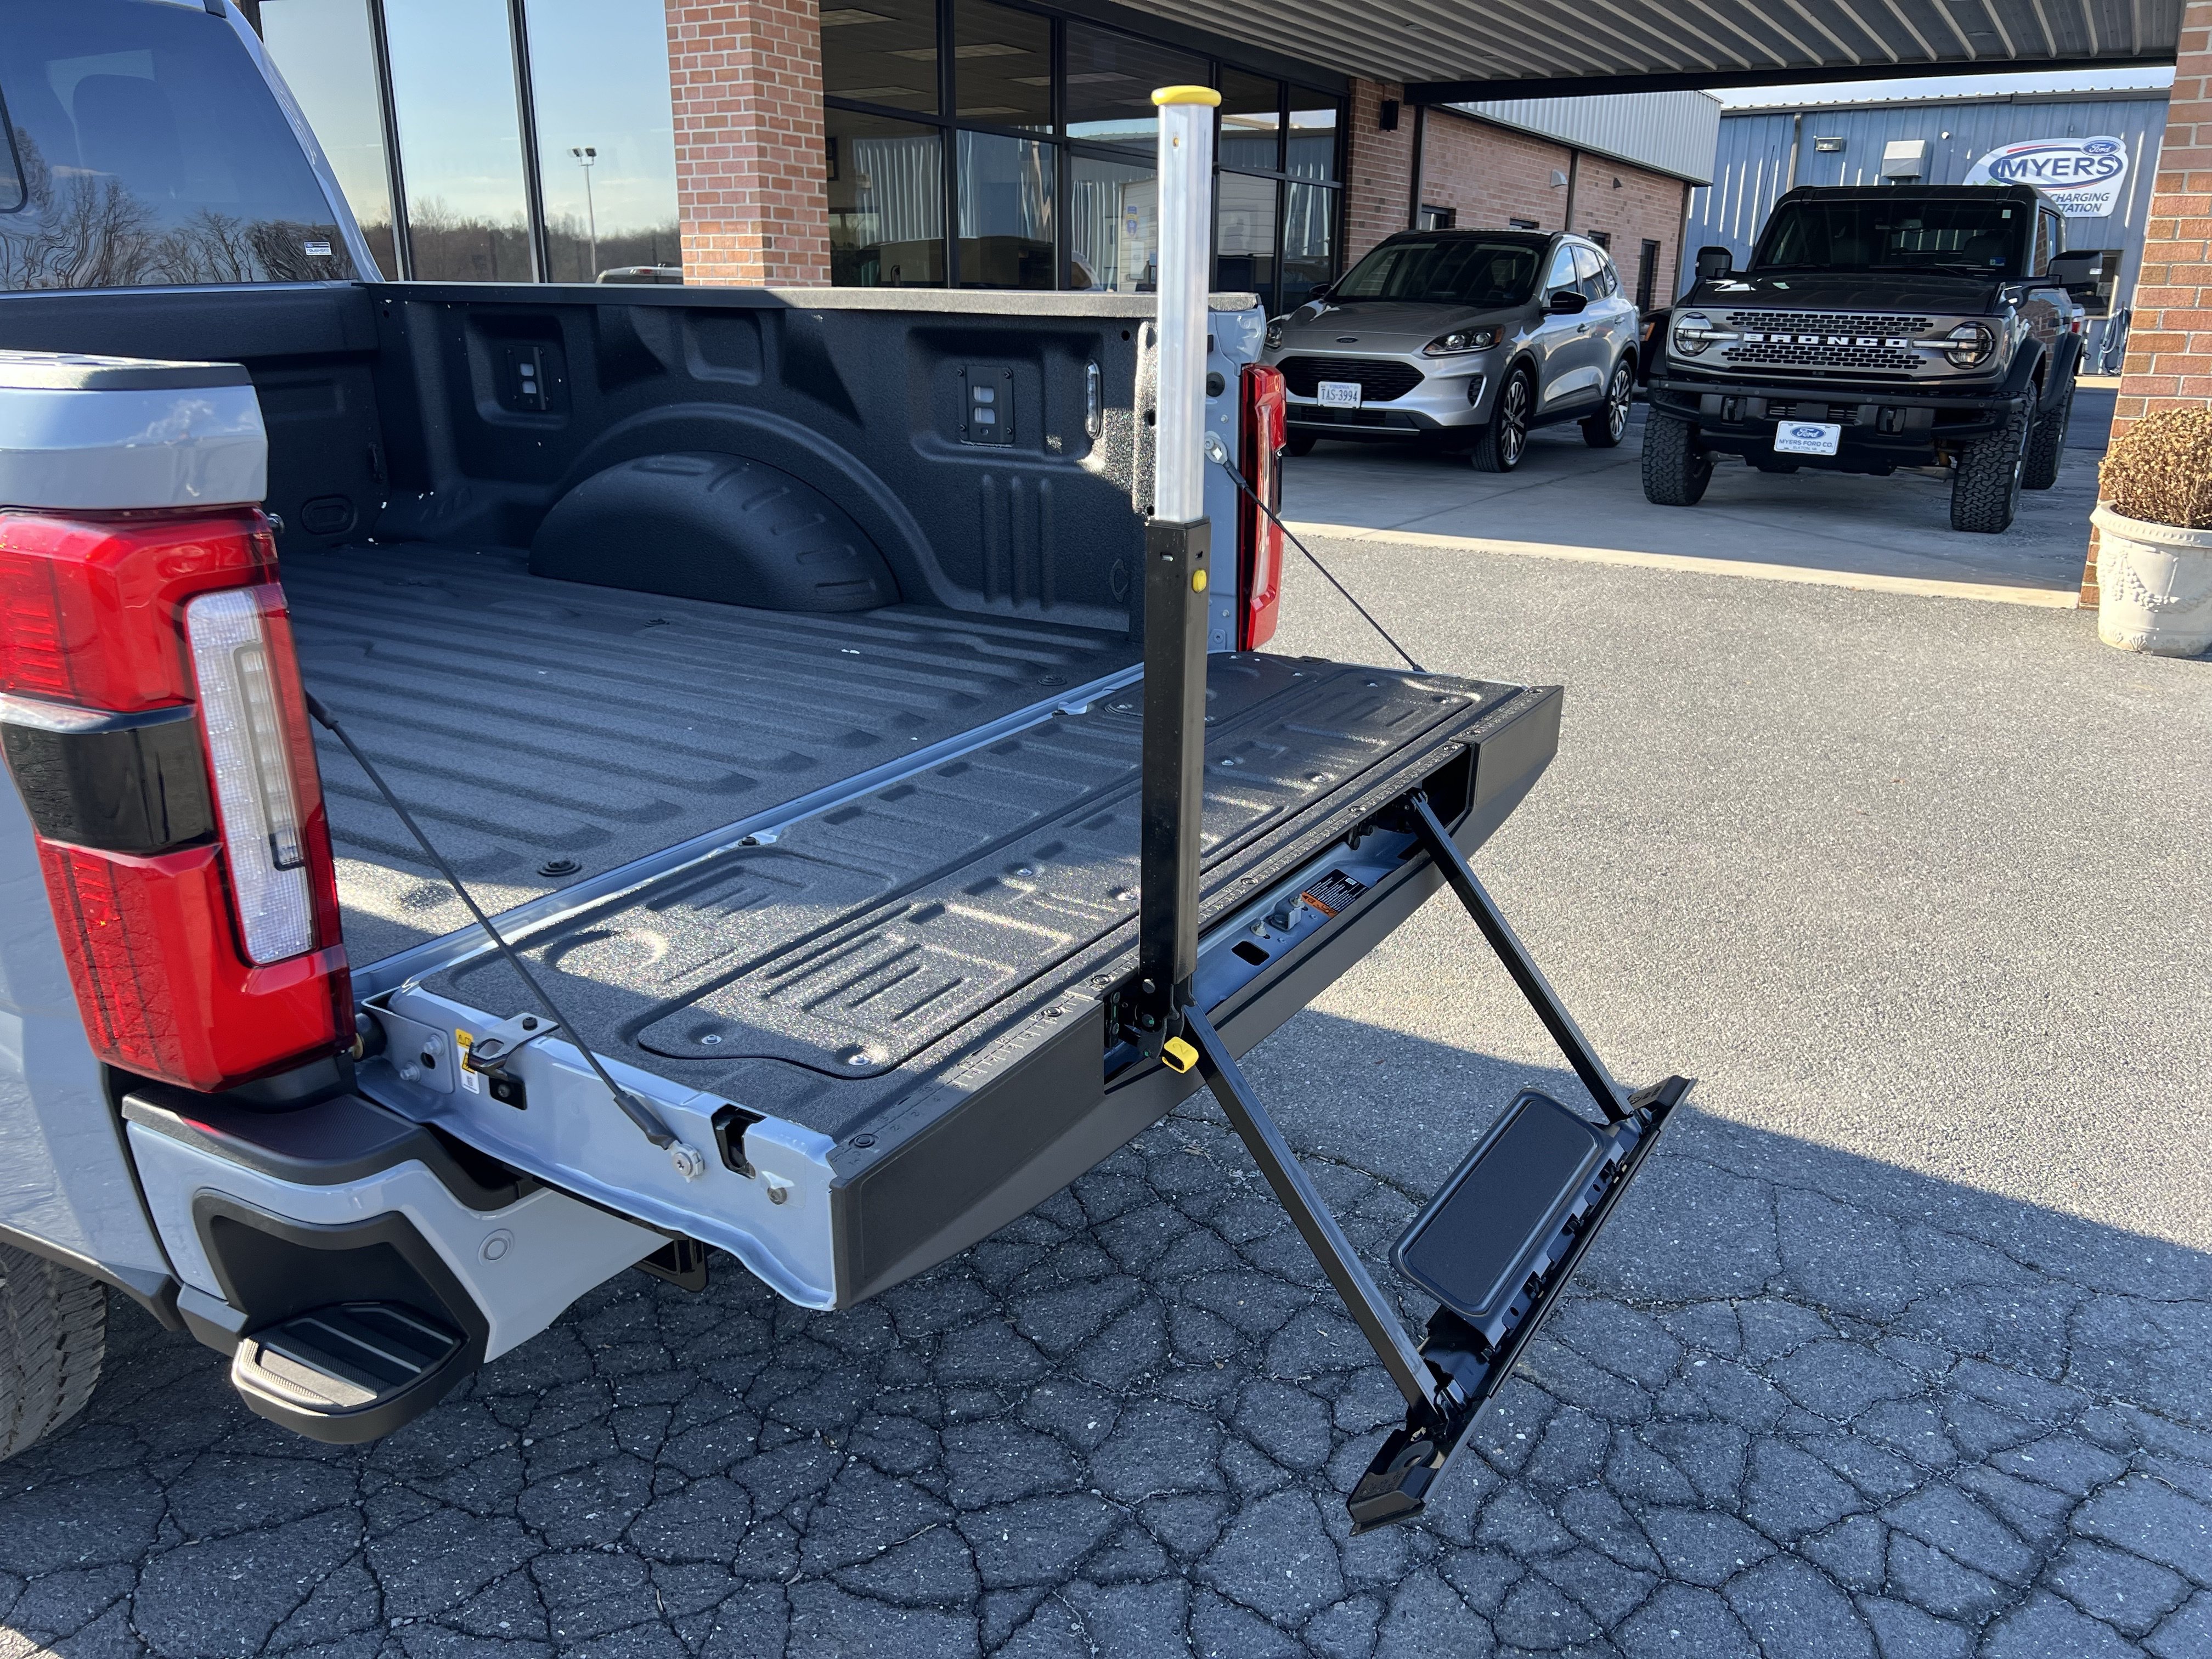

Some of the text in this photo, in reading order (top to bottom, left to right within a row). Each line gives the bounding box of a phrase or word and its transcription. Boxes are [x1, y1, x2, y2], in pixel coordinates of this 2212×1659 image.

[2089, 144, 2111, 153] Ford
[2000, 156, 2117, 178] MYERS
[2057, 203, 2102, 213] TATION
[1743, 332, 1908, 348] BRONCO
[1321, 388, 1357, 402] TAS-3994
[1796, 428, 1819, 437] Ford
